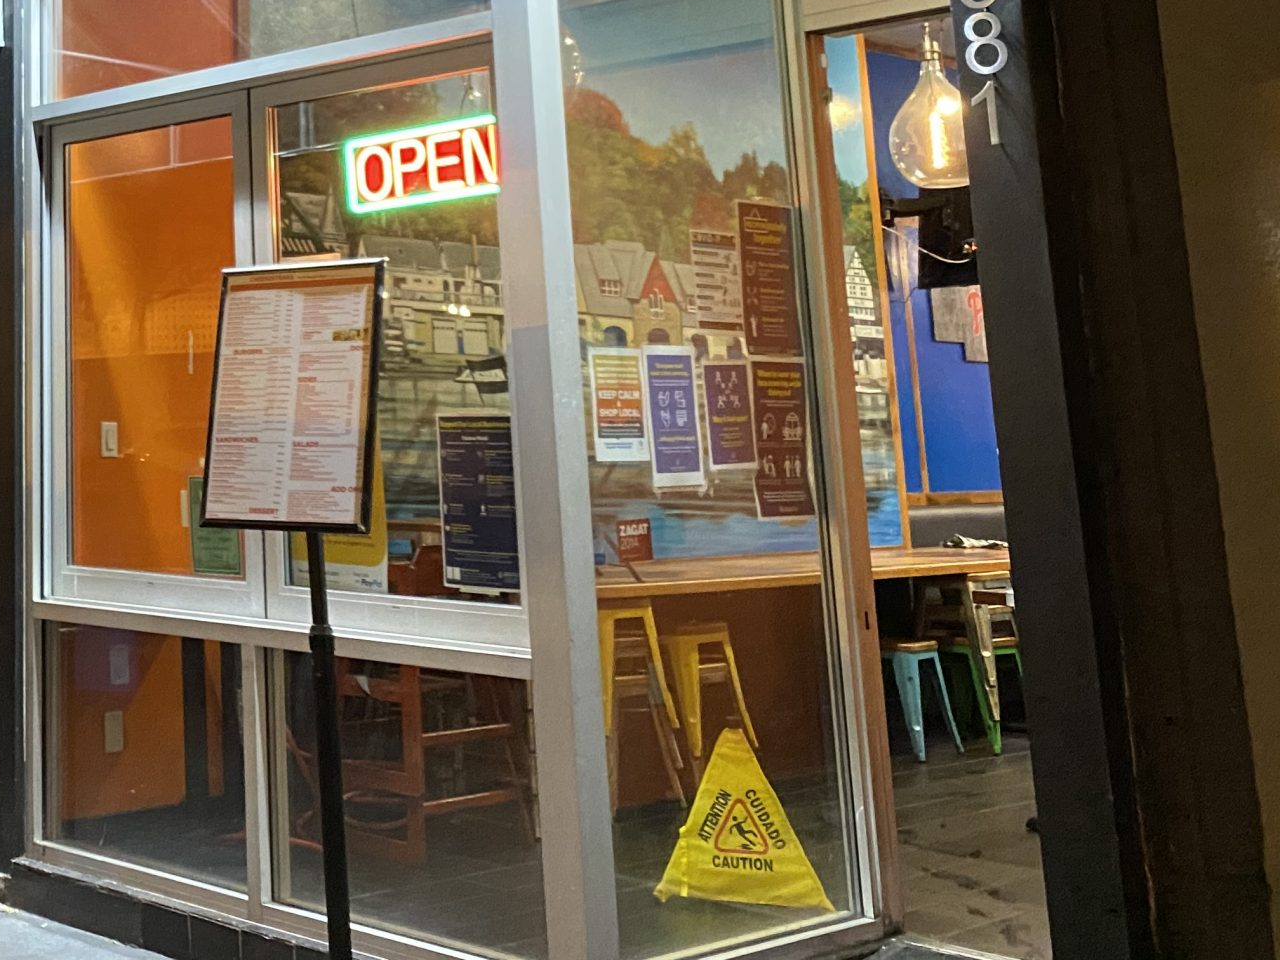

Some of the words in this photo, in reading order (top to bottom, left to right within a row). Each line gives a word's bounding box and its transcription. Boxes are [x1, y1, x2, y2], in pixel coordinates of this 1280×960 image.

[356, 127, 498, 202] OPEN
[619, 523, 649, 537] ZAGAT
[697, 788, 733, 843] ATTENTION
[745, 789, 786, 850] CUIDADO
[712, 854, 774, 872] CAUTION
